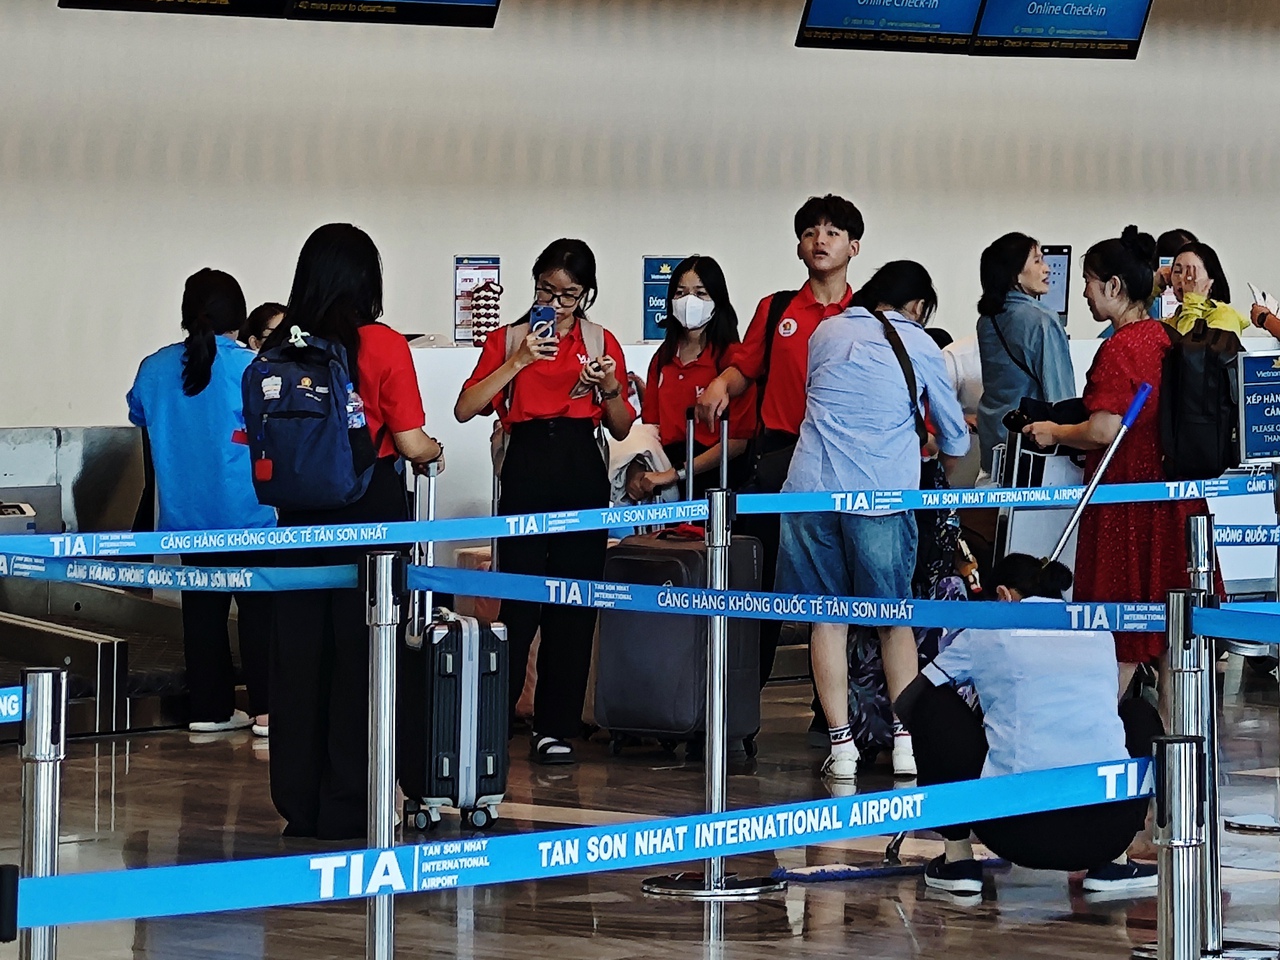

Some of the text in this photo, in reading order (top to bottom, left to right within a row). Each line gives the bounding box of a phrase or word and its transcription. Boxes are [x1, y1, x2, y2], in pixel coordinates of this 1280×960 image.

[1027, 1, 1107, 16] Online Check-in
[1252, 424, 1275, 433] PLEASE
[922, 490, 1050, 505] TAN SON NHAT INTERNATIONAL
[1165, 482, 1200, 498] TIA
[831, 493, 868, 510] TIA
[601, 506, 673, 524] TAN SON NHAT
[506, 515, 538, 534] TIA
[161, 524, 387, 549] CẢNG HÀNG KHÔNG QUỐC TẾ TÂN SƠN NHẤT
[49, 536, 87, 556] TIA
[545, 580, 582, 605] TIA
[657, 589, 914, 619] CẢNG HÀNG KHÔNG QUỐC TẾ TÂN SƠN NHẤT
[1066, 604, 1110, 629] TIA
[1097, 760, 1156, 800] TIA
[538, 793, 926, 867] TAN SON NHAT INTERNATIONAL AIRPORT
[422, 840, 488, 857] TAN SON NHAT
[421, 856, 490, 873] INTERNATIONAL
[309, 850, 407, 899] TIA
[421, 875, 459, 889] AIRPORT
